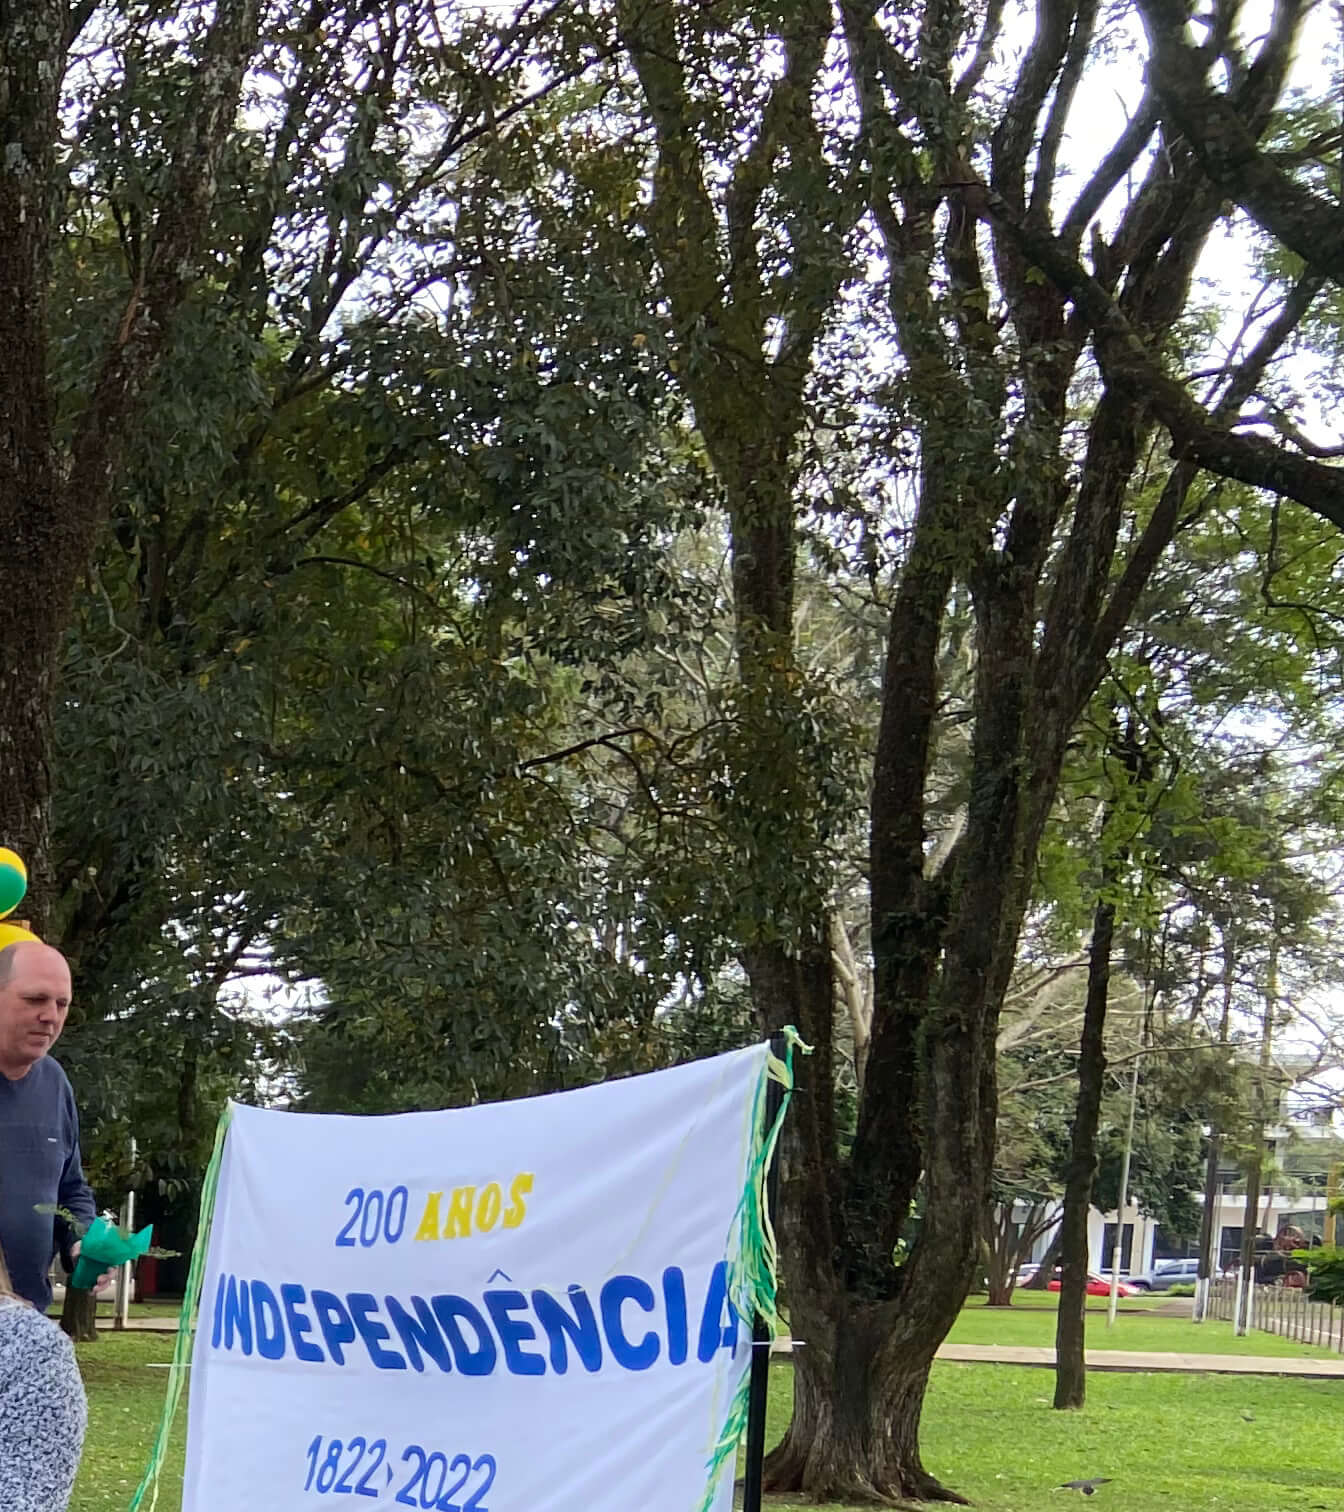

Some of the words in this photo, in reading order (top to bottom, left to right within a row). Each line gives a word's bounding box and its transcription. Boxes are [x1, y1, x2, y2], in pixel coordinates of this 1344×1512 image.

[335, 1185, 409, 1248] 200
[414, 1170, 535, 1242] ANOS
[212, 1260, 737, 1376] INDEPENDÊNCIA
